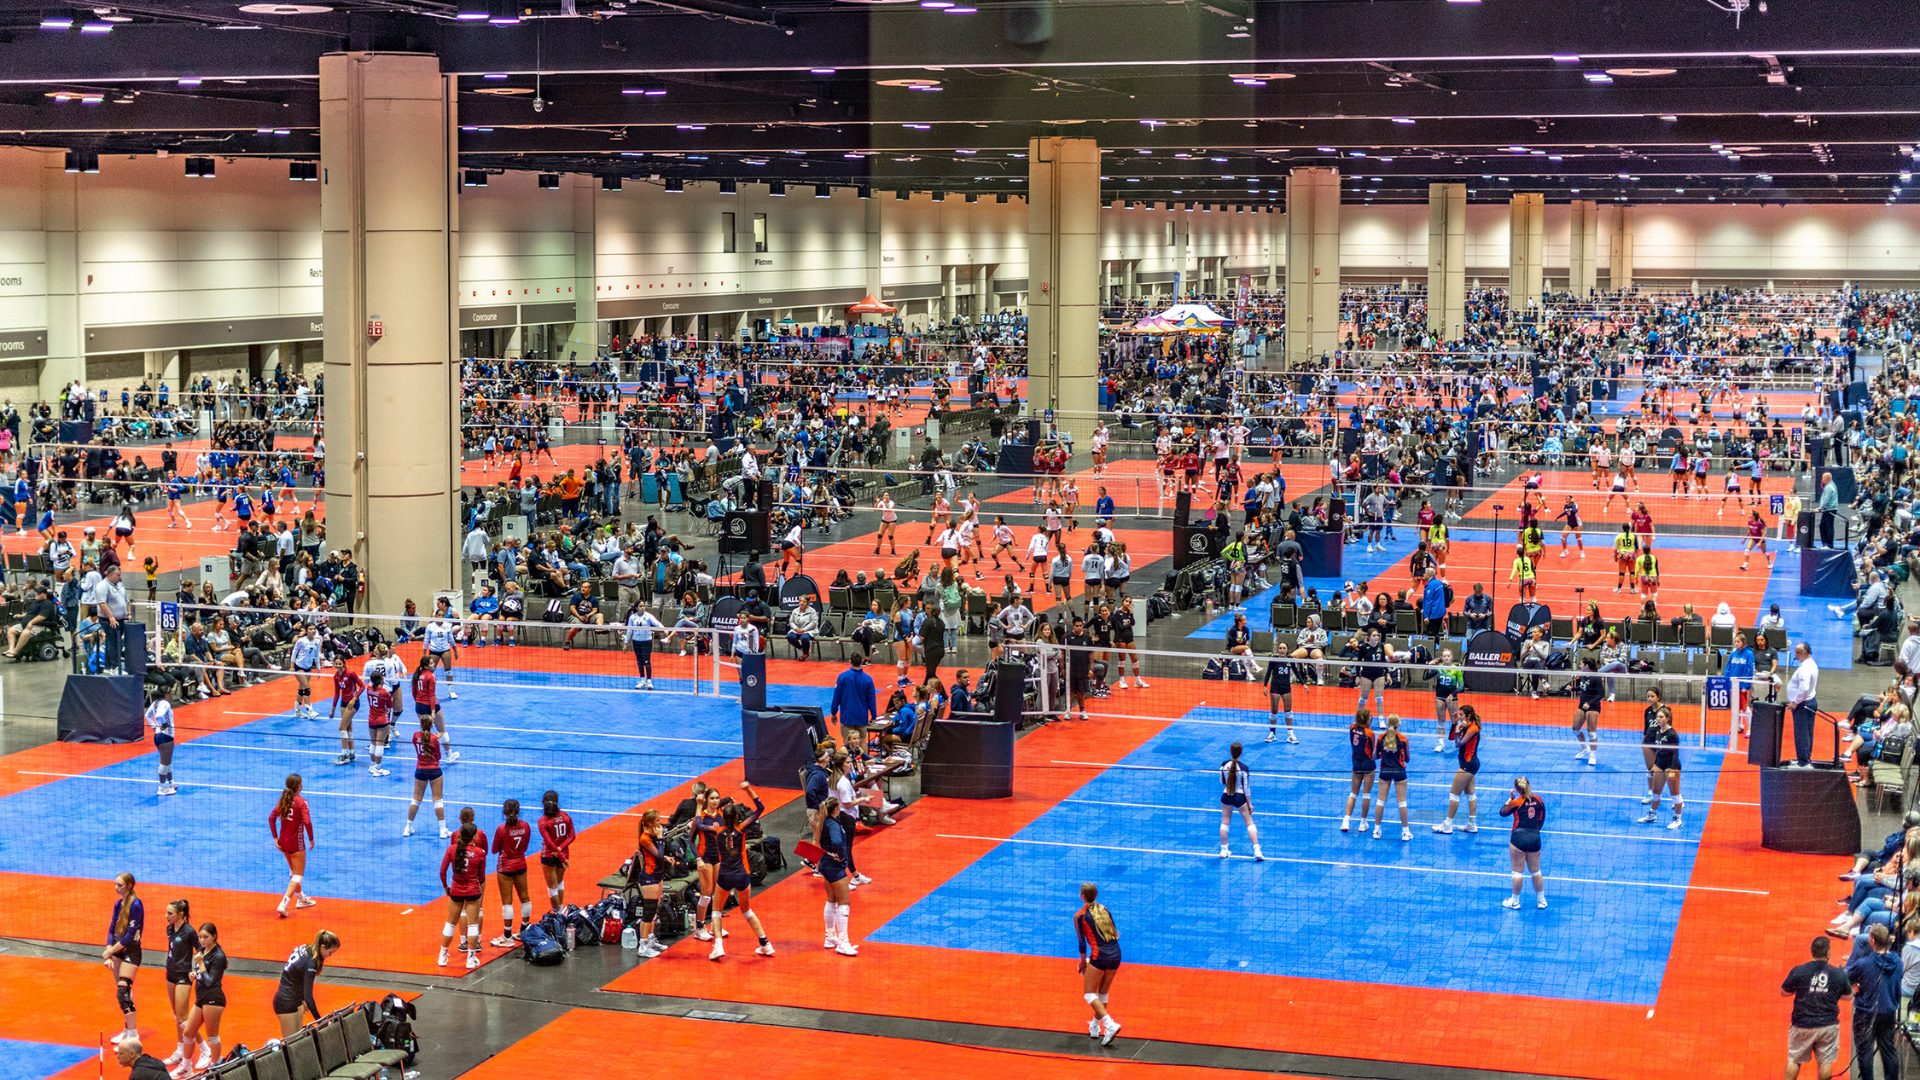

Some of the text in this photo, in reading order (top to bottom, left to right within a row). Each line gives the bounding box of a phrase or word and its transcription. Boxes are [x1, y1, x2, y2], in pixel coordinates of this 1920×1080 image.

[663, 302, 680, 310] Concourse
[473, 313, 498, 322] Concourse
[790, 473, 799, 482] 77
[1772, 503, 1783, 514] 78
[1434, 530, 1440, 539] 4
[163, 613, 176, 628] 85
[711, 616, 738, 626] BALLER
[1372, 653, 1382, 661] 12
[1469, 652, 1500, 662] BALLER
[1278, 666, 1288, 675] 24
[1440, 675, 1452, 686] 32
[369, 695, 378, 707] 12
[1710, 690, 1728, 707] 86
[554, 823, 567, 839] 10
[513, 836, 522, 849] 7
[1811, 973, 1829, 988] #9
